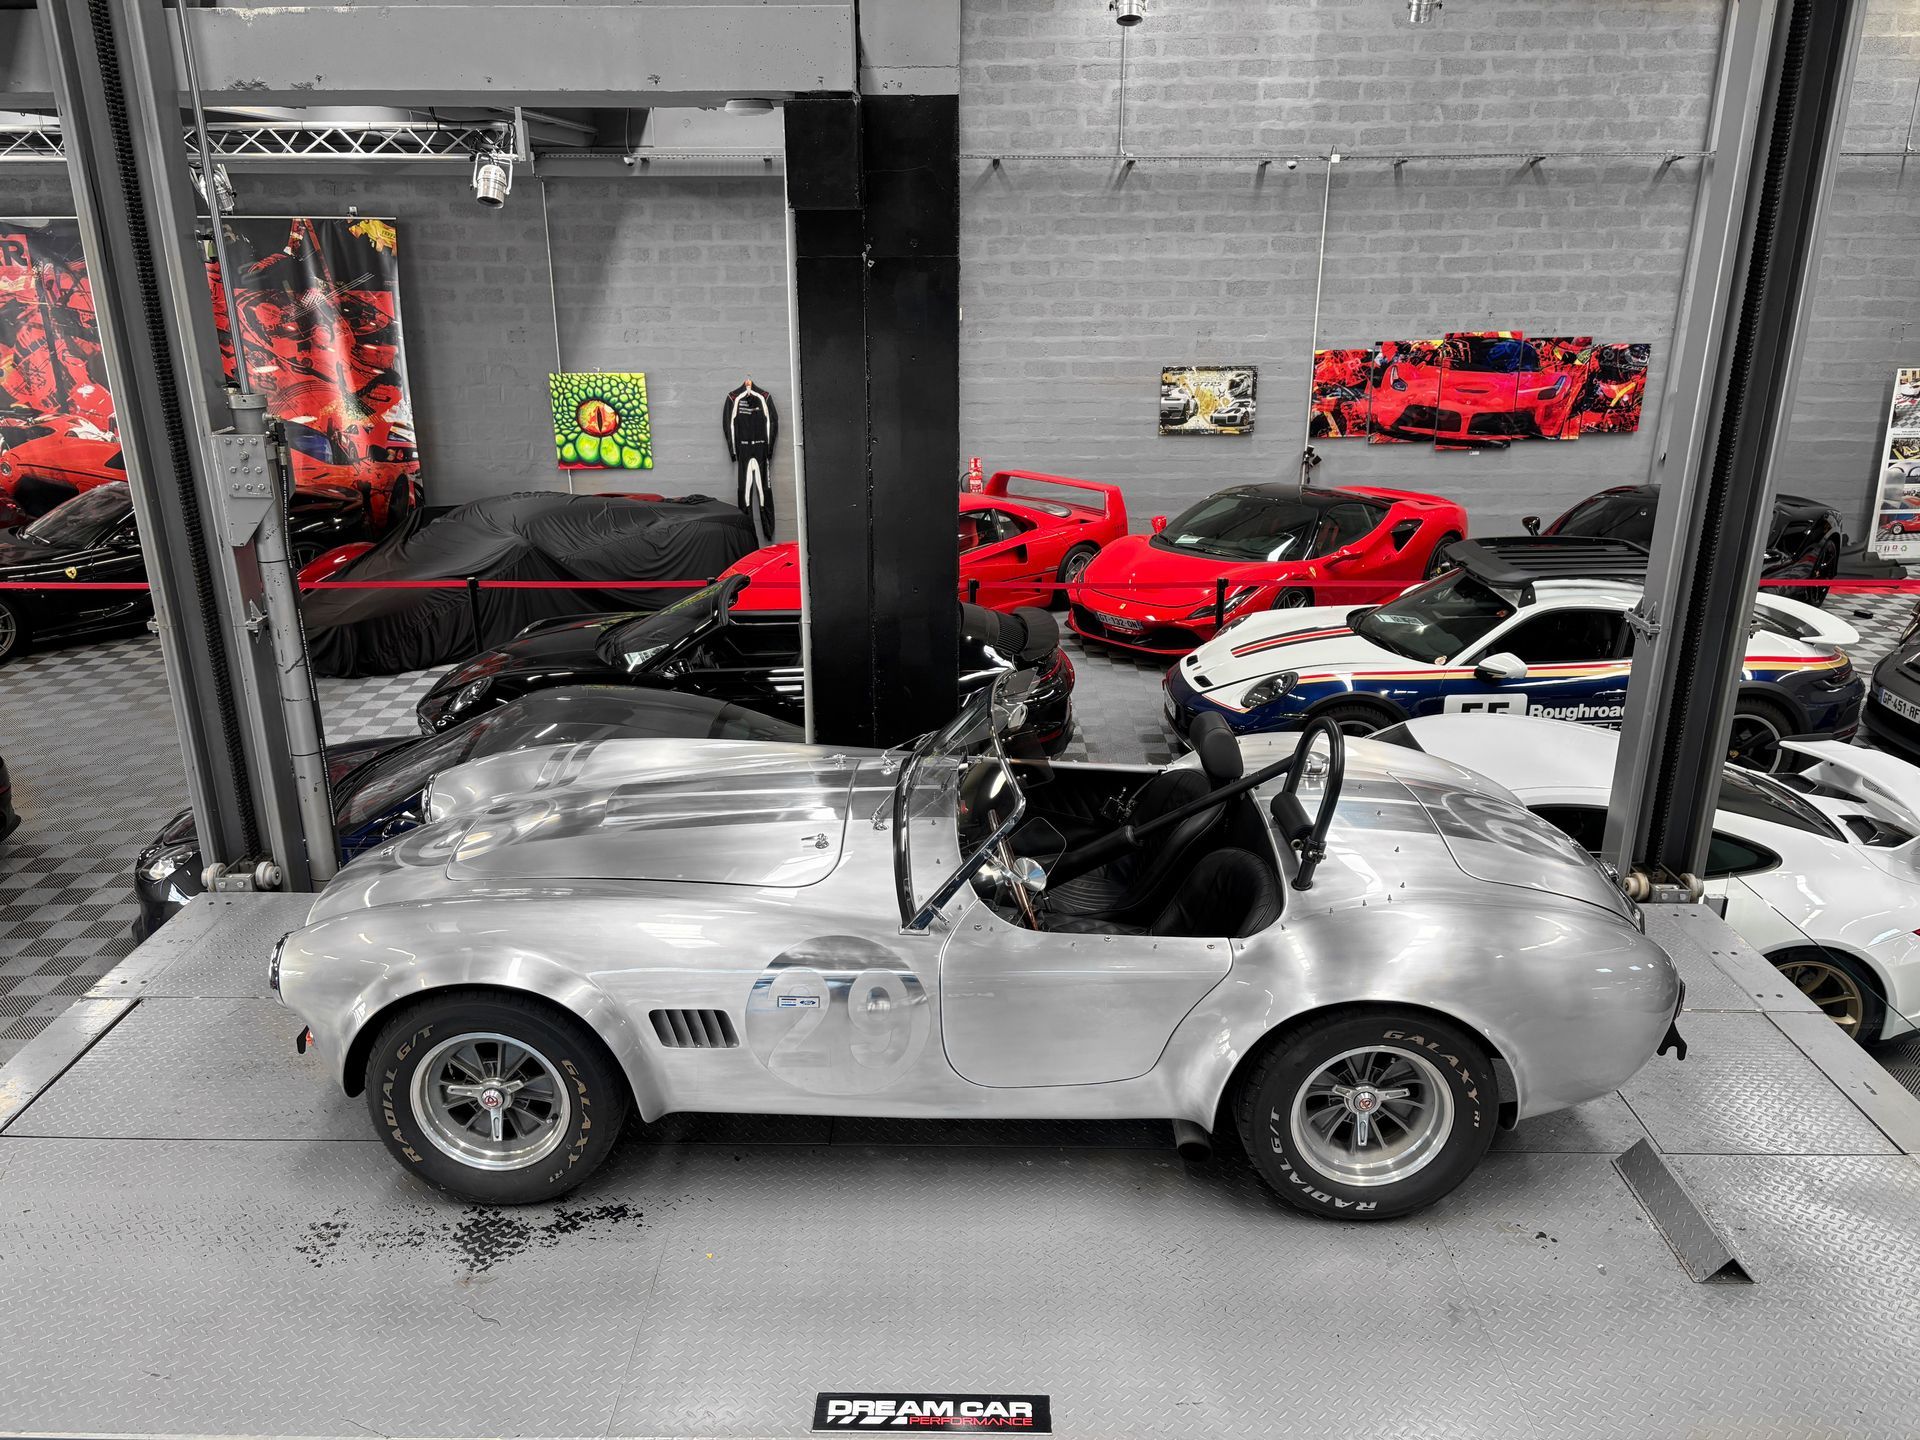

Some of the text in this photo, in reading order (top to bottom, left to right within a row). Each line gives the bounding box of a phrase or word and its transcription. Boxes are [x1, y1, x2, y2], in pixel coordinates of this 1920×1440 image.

[382, 1024, 434, 1163] RADIAL G/T
[1383, 1030, 1480, 1105] GALAXY
[561, 1060, 591, 1169] GALAXY
[1269, 1106, 1377, 1211] RADIAL G/T
[827, 1400, 1033, 1418] DREAM CAR
[909, 1416, 1033, 1426] PERFORMANCE
